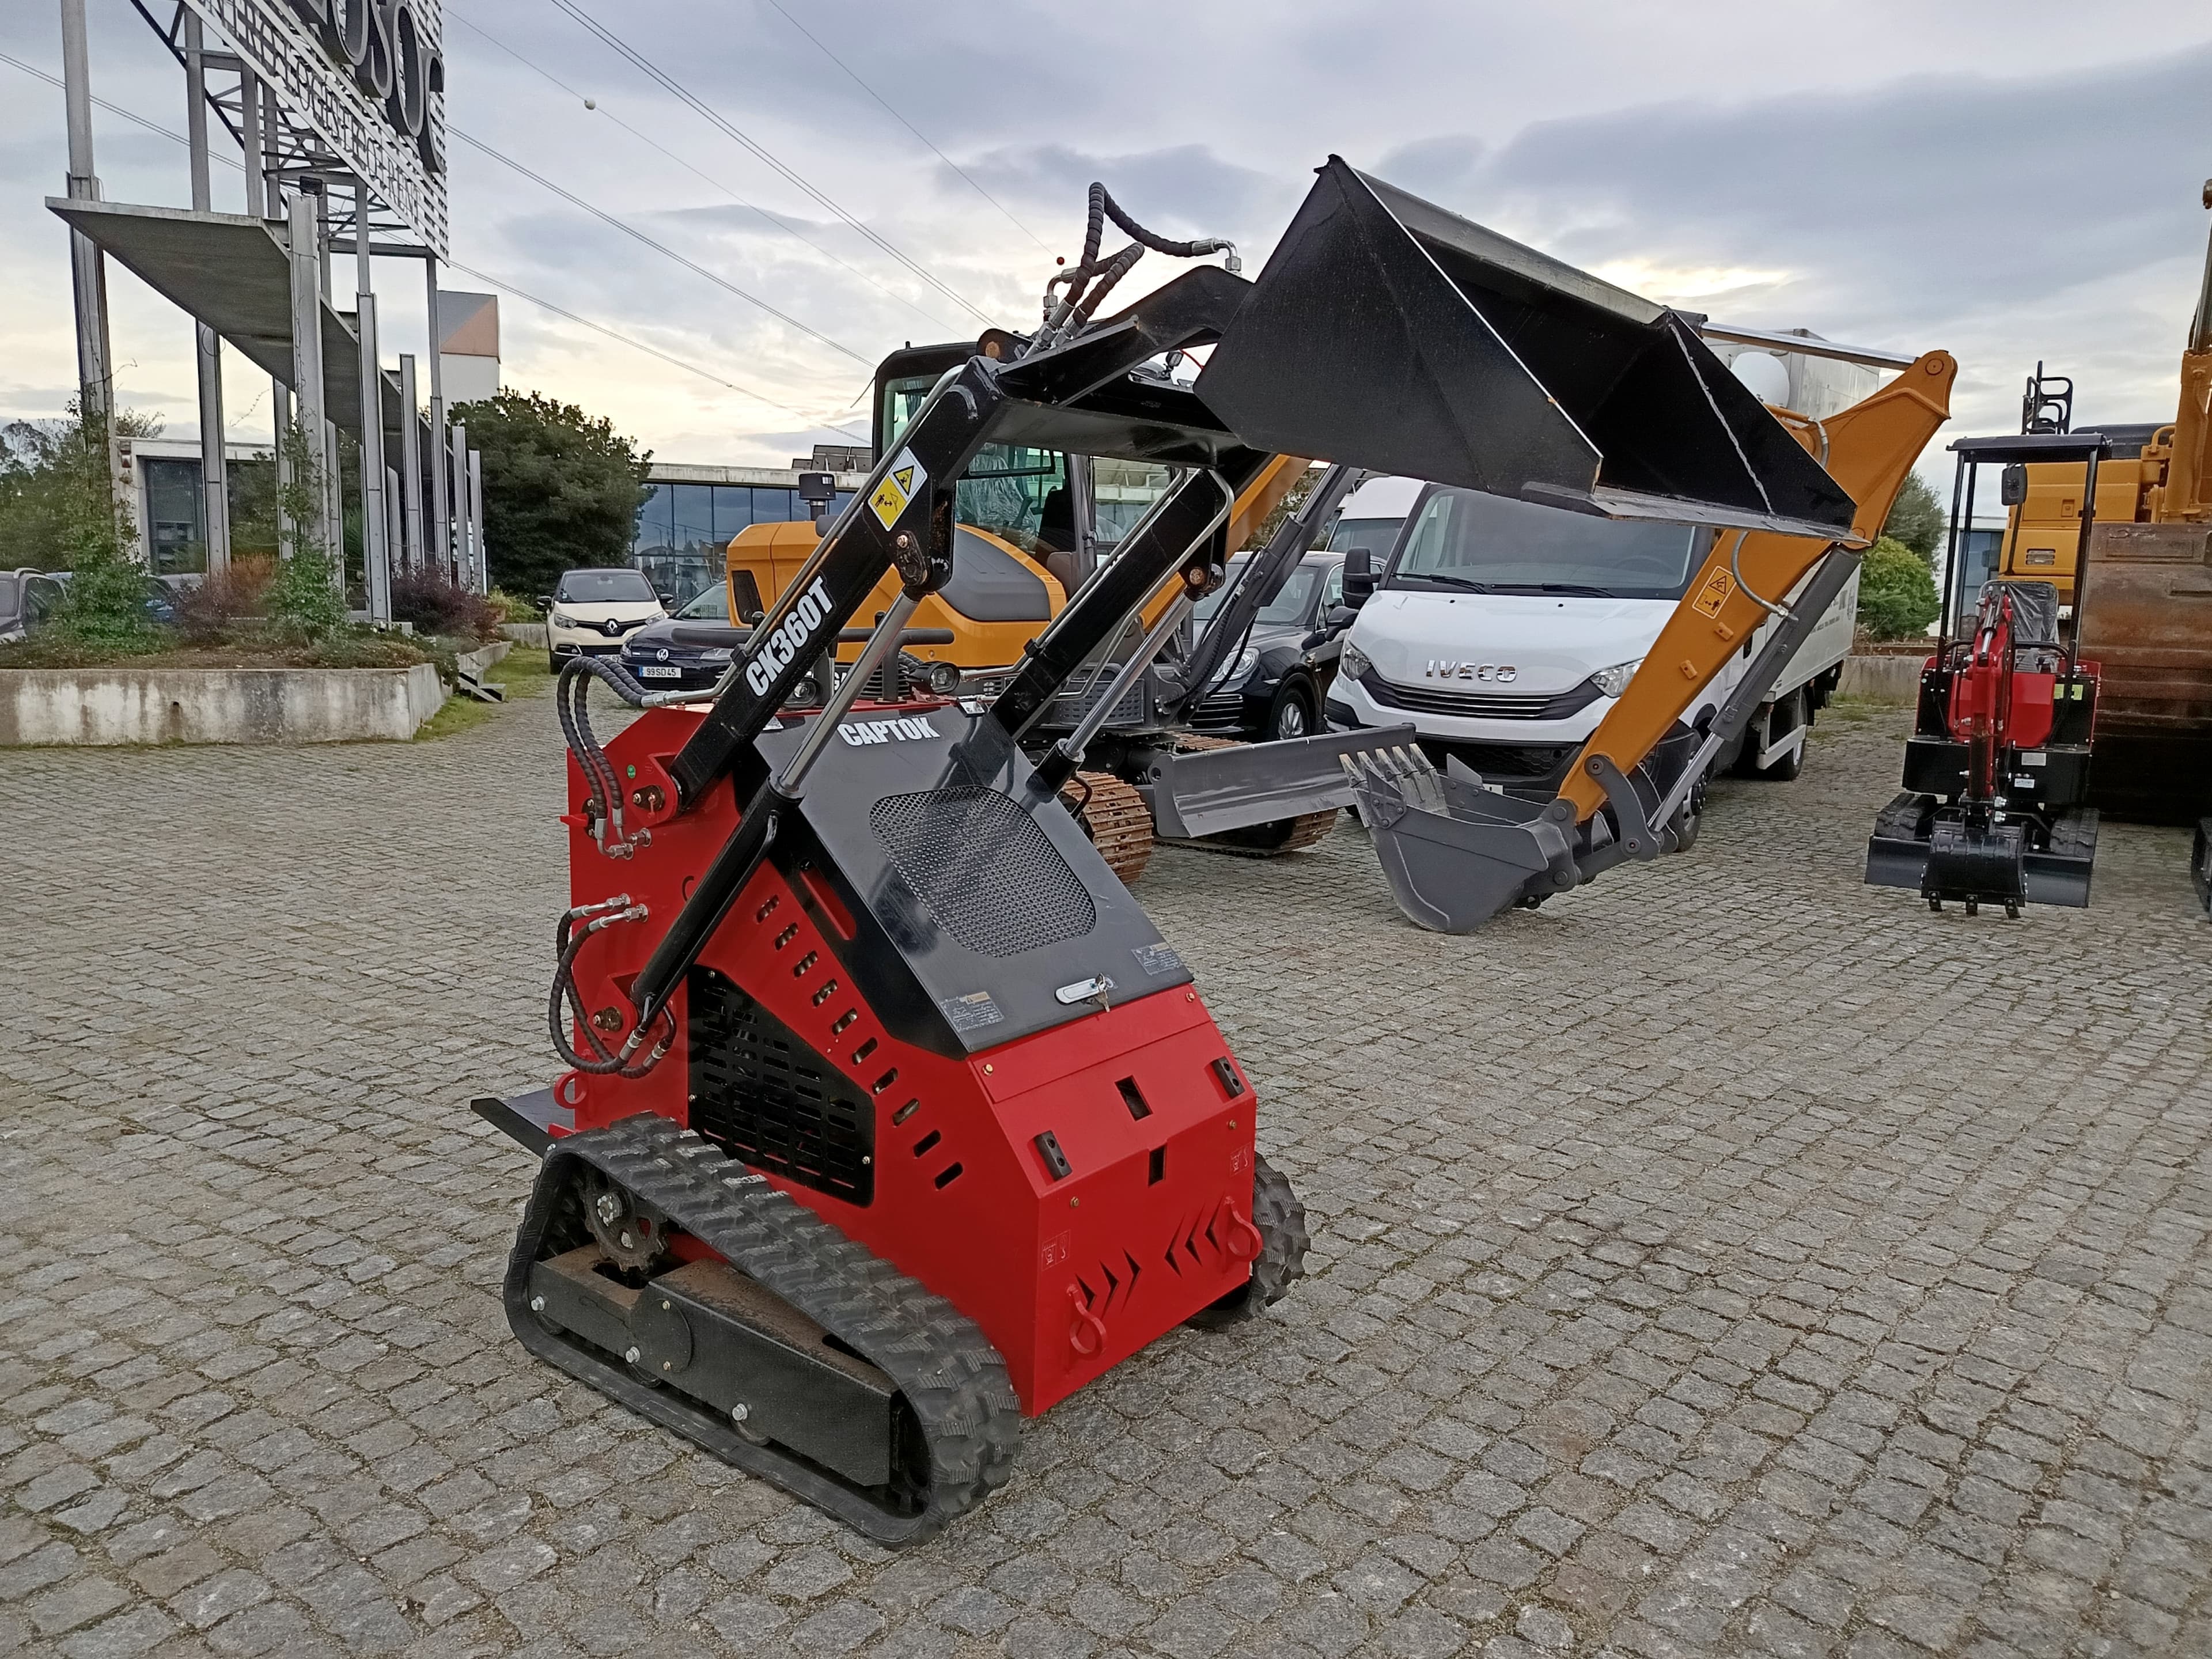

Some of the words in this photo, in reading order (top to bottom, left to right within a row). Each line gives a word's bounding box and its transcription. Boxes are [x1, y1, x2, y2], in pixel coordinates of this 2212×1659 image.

[746, 576, 832, 696] CK360T
[1426, 660, 1517, 683] IVECO
[836, 717, 940, 746] CAPTOK
